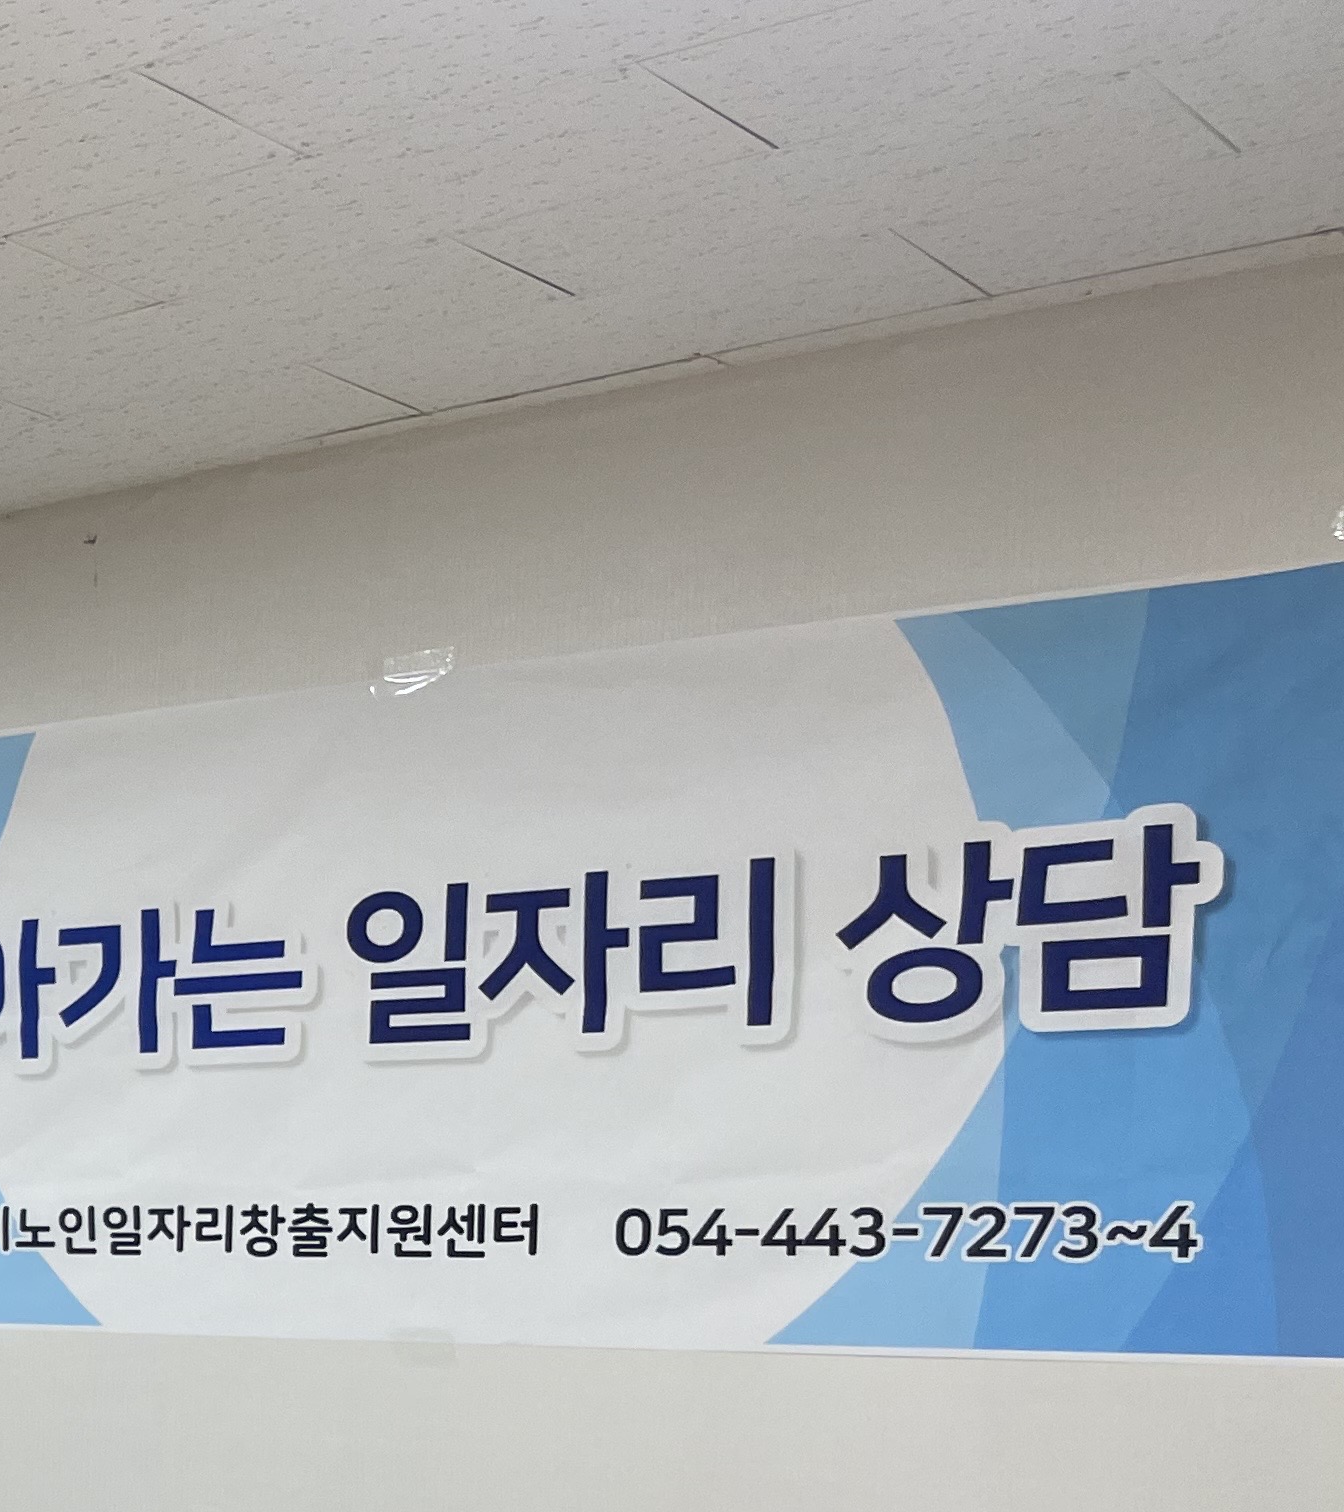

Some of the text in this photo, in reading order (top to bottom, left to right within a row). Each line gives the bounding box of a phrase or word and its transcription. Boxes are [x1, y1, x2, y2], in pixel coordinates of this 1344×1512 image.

[345, 857, 777, 1045] 일자리
[835, 823, 1202, 1024] 상담
[614, 1206, 1200, 1261] 054-443-7273~4
